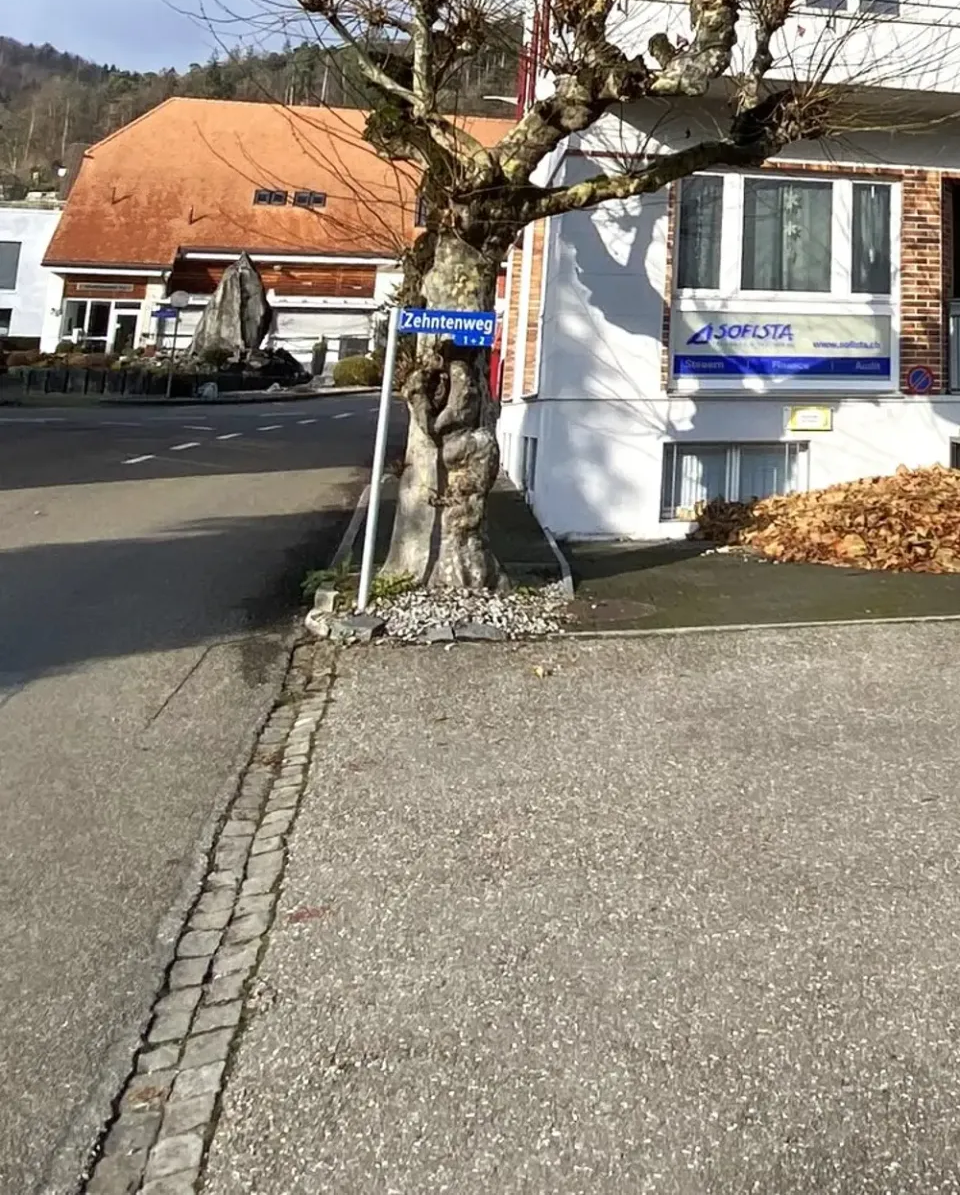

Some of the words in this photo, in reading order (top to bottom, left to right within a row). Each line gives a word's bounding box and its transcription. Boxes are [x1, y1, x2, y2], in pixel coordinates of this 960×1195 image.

[404, 312, 493, 335] Zehntenweg
[463, 336, 468, 345] 1
[479, 336, 485, 345] 2
[714, 324, 793, 341] SOFISTA
